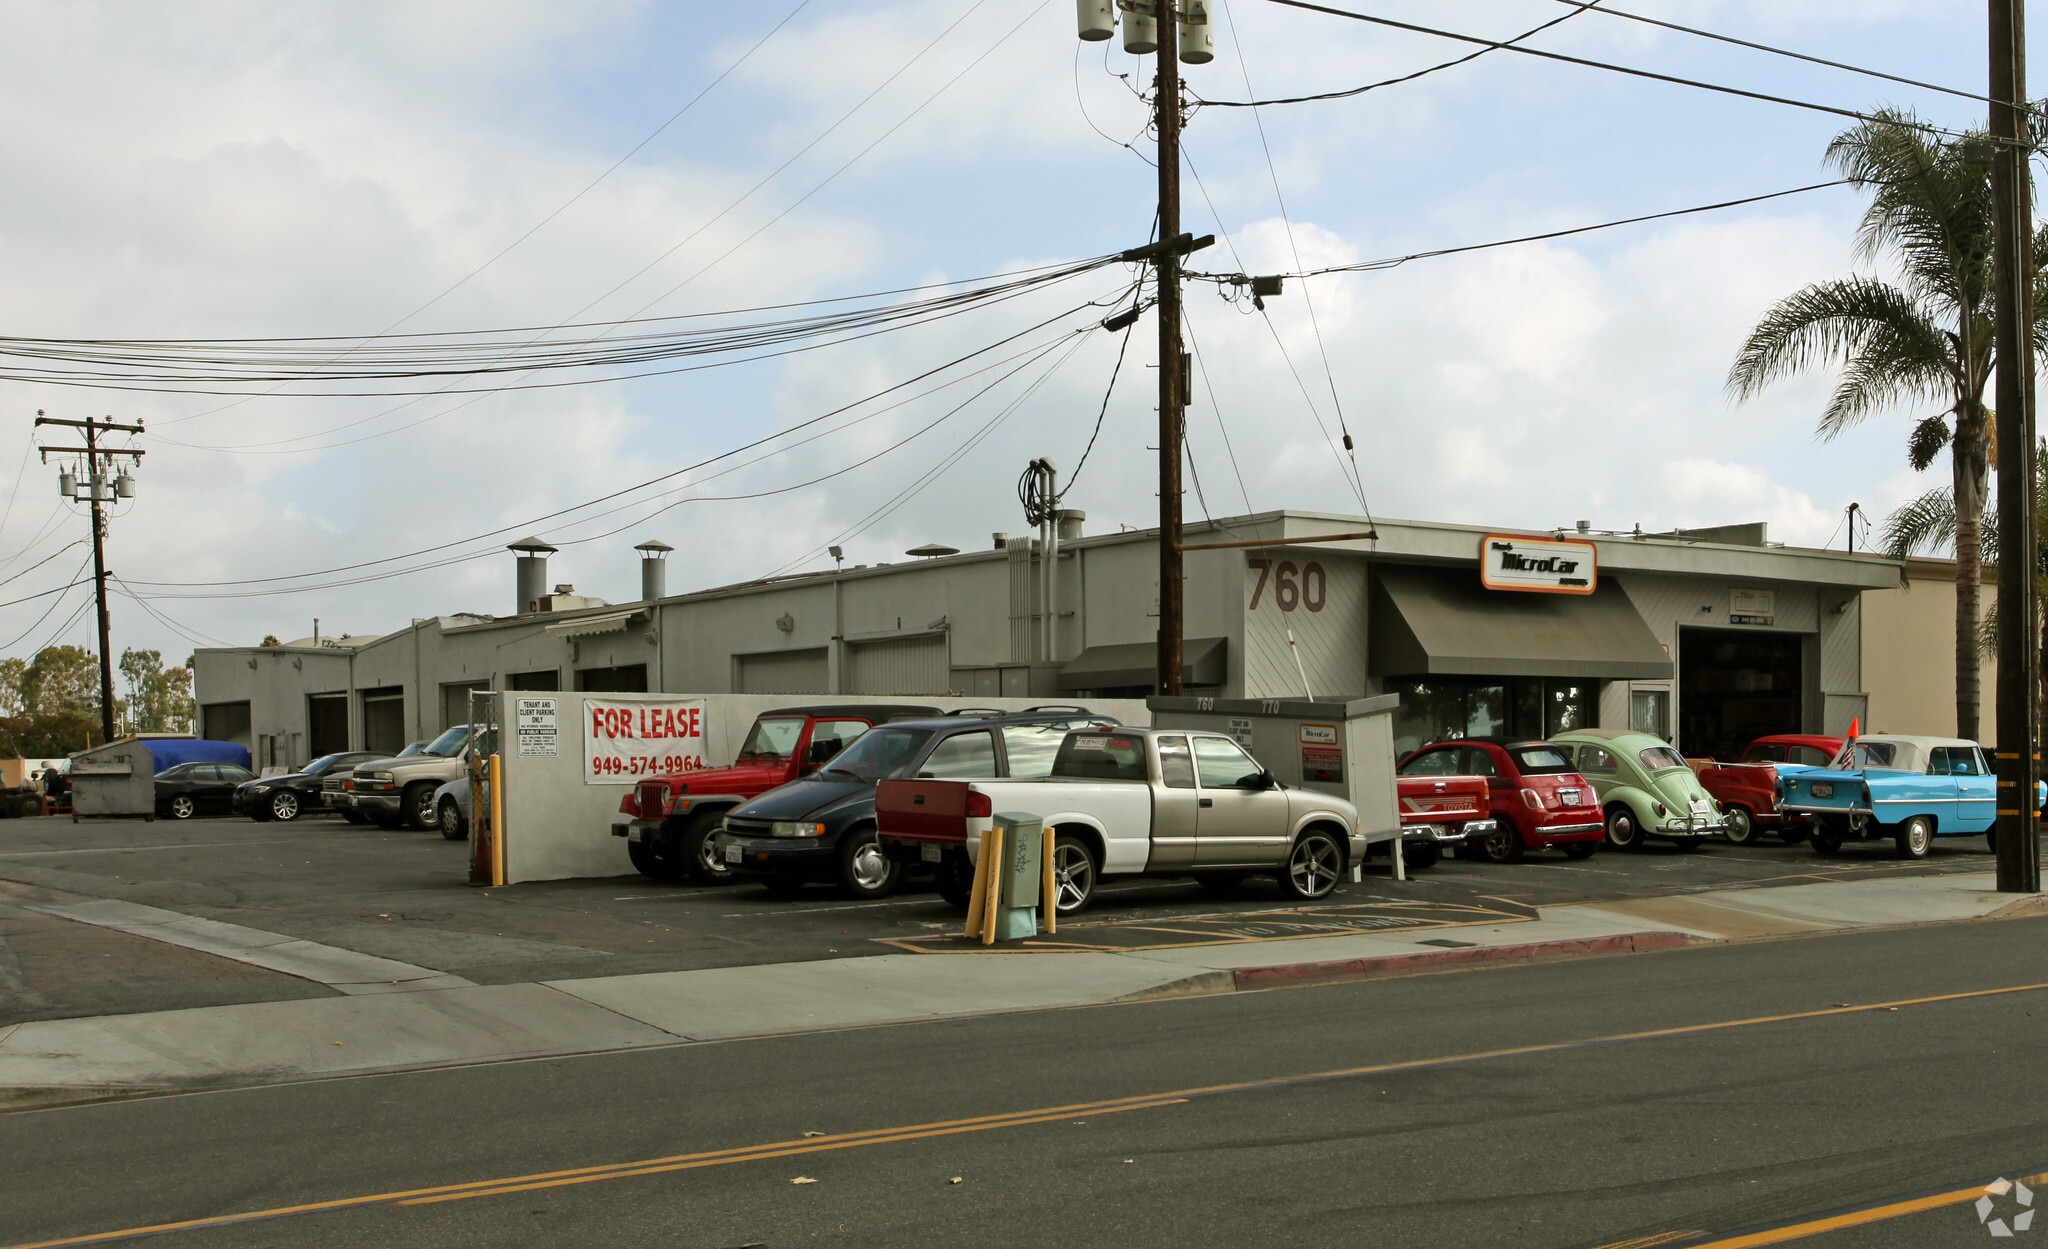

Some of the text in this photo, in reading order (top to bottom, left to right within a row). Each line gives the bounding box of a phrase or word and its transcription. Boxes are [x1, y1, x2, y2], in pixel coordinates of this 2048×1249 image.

[1501, 552, 1579, 574] MicroCar
[1247, 559, 1327, 613] 760
[1197, 697, 1214, 711] 760
[1262, 700, 1280, 714] 770
[592, 708, 700, 739] FOR LEASE
[592, 755, 703, 775] 949-574-9964
[1442, 803, 1473, 811] TOYOTA
